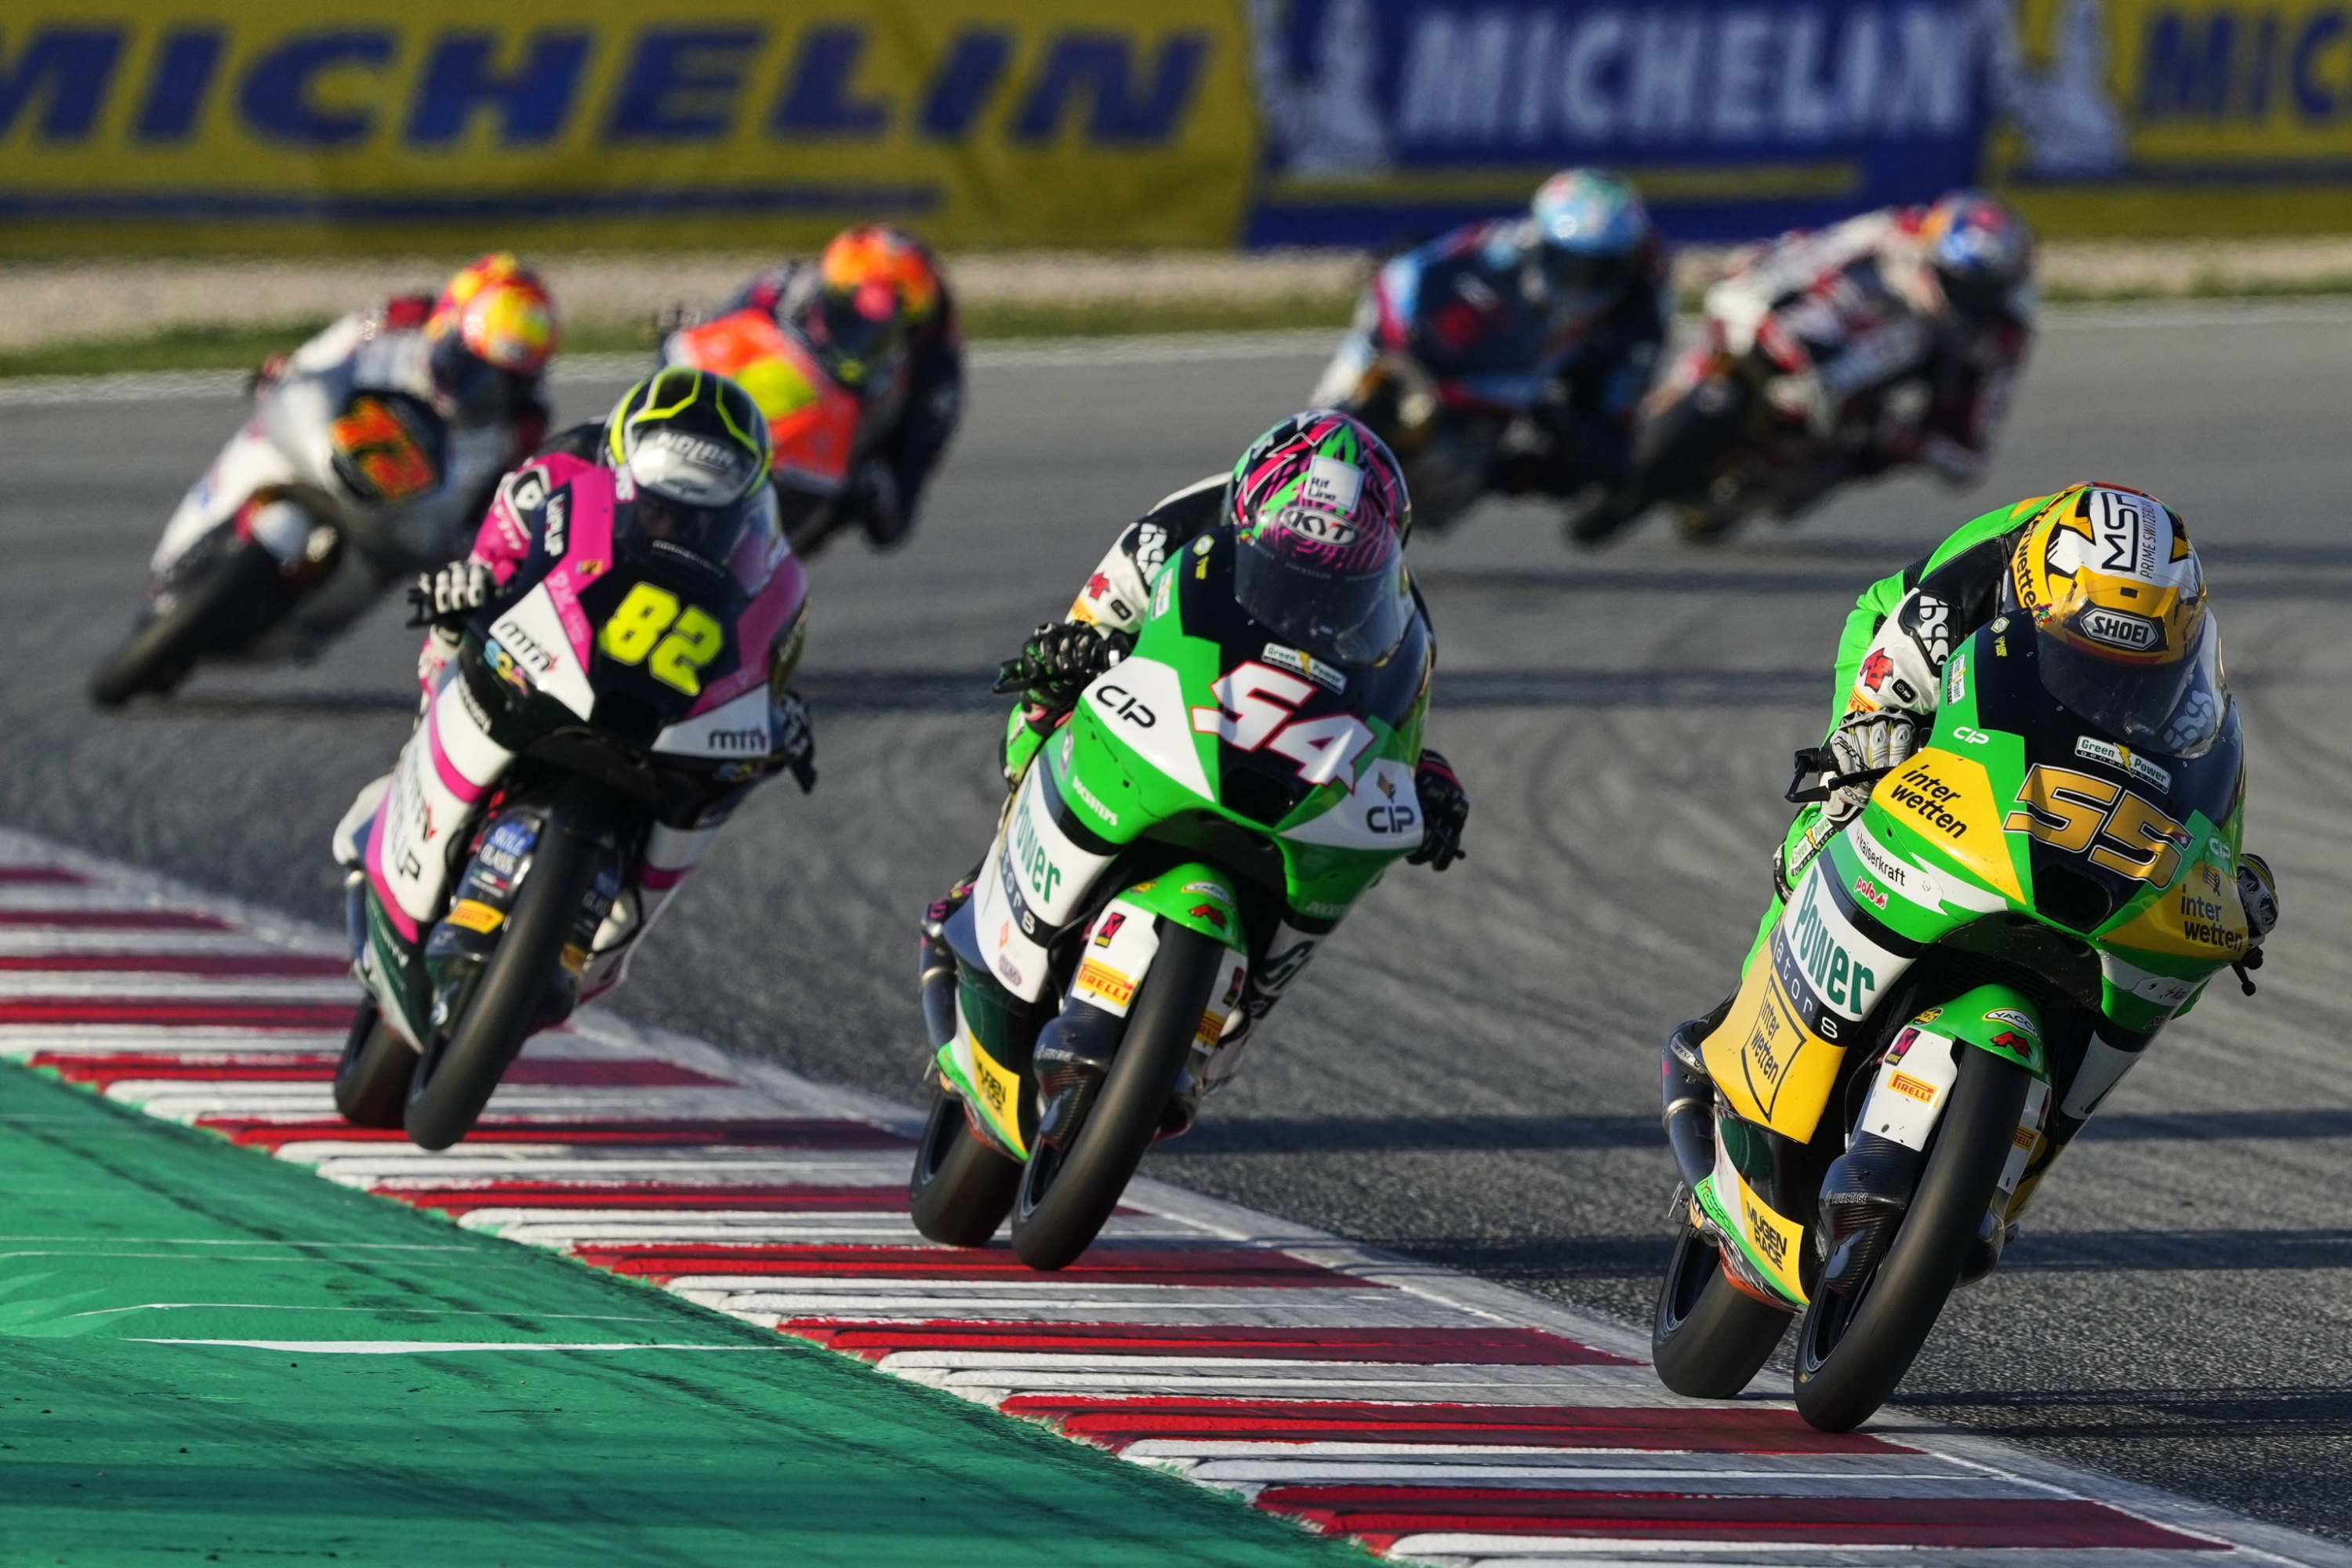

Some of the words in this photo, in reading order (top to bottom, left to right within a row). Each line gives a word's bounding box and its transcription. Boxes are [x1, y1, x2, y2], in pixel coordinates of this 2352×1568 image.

[0, 25, 1209, 147] MICHELIN
[1399, 13, 1974, 141] MICHELIN
[655, 432, 738, 468] NOLAN
[1292, 511, 1353, 542] KYT
[2140, 541, 2156, 579] PRIME
[597, 581, 724, 697] 82
[2092, 615, 2150, 644] SHOEI
[1095, 685, 1156, 728] CIP
[1191, 659, 1378, 797] 54
[1953, 726, 1990, 744] CIP
[2082, 739, 2115, 757] Green
[2134, 757, 2167, 782] Power
[1901, 764, 1962, 803] inter
[1366, 805, 1415, 833] CIP
[1889, 784, 1968, 839] wetten
[2001, 763, 2194, 891] 55
[1859, 833, 1907, 887] kaiserkraft
[2209, 837, 2232, 859] CIP
[1855, 878, 1876, 901] polo
[2180, 884, 2222, 921] inter
[1792, 865, 1875, 1016] Power
[2183, 920, 2243, 952] wetten
[1078, 963, 1135, 1002] PIRELLI
[1761, 990, 1780, 1040] inter
[1751, 1025, 1780, 1085] wetten
[1893, 1074, 1935, 1102] PIRELLI
[1746, 1200, 1788, 1257] MUGEN
[1754, 1225, 1784, 1272] RACE
